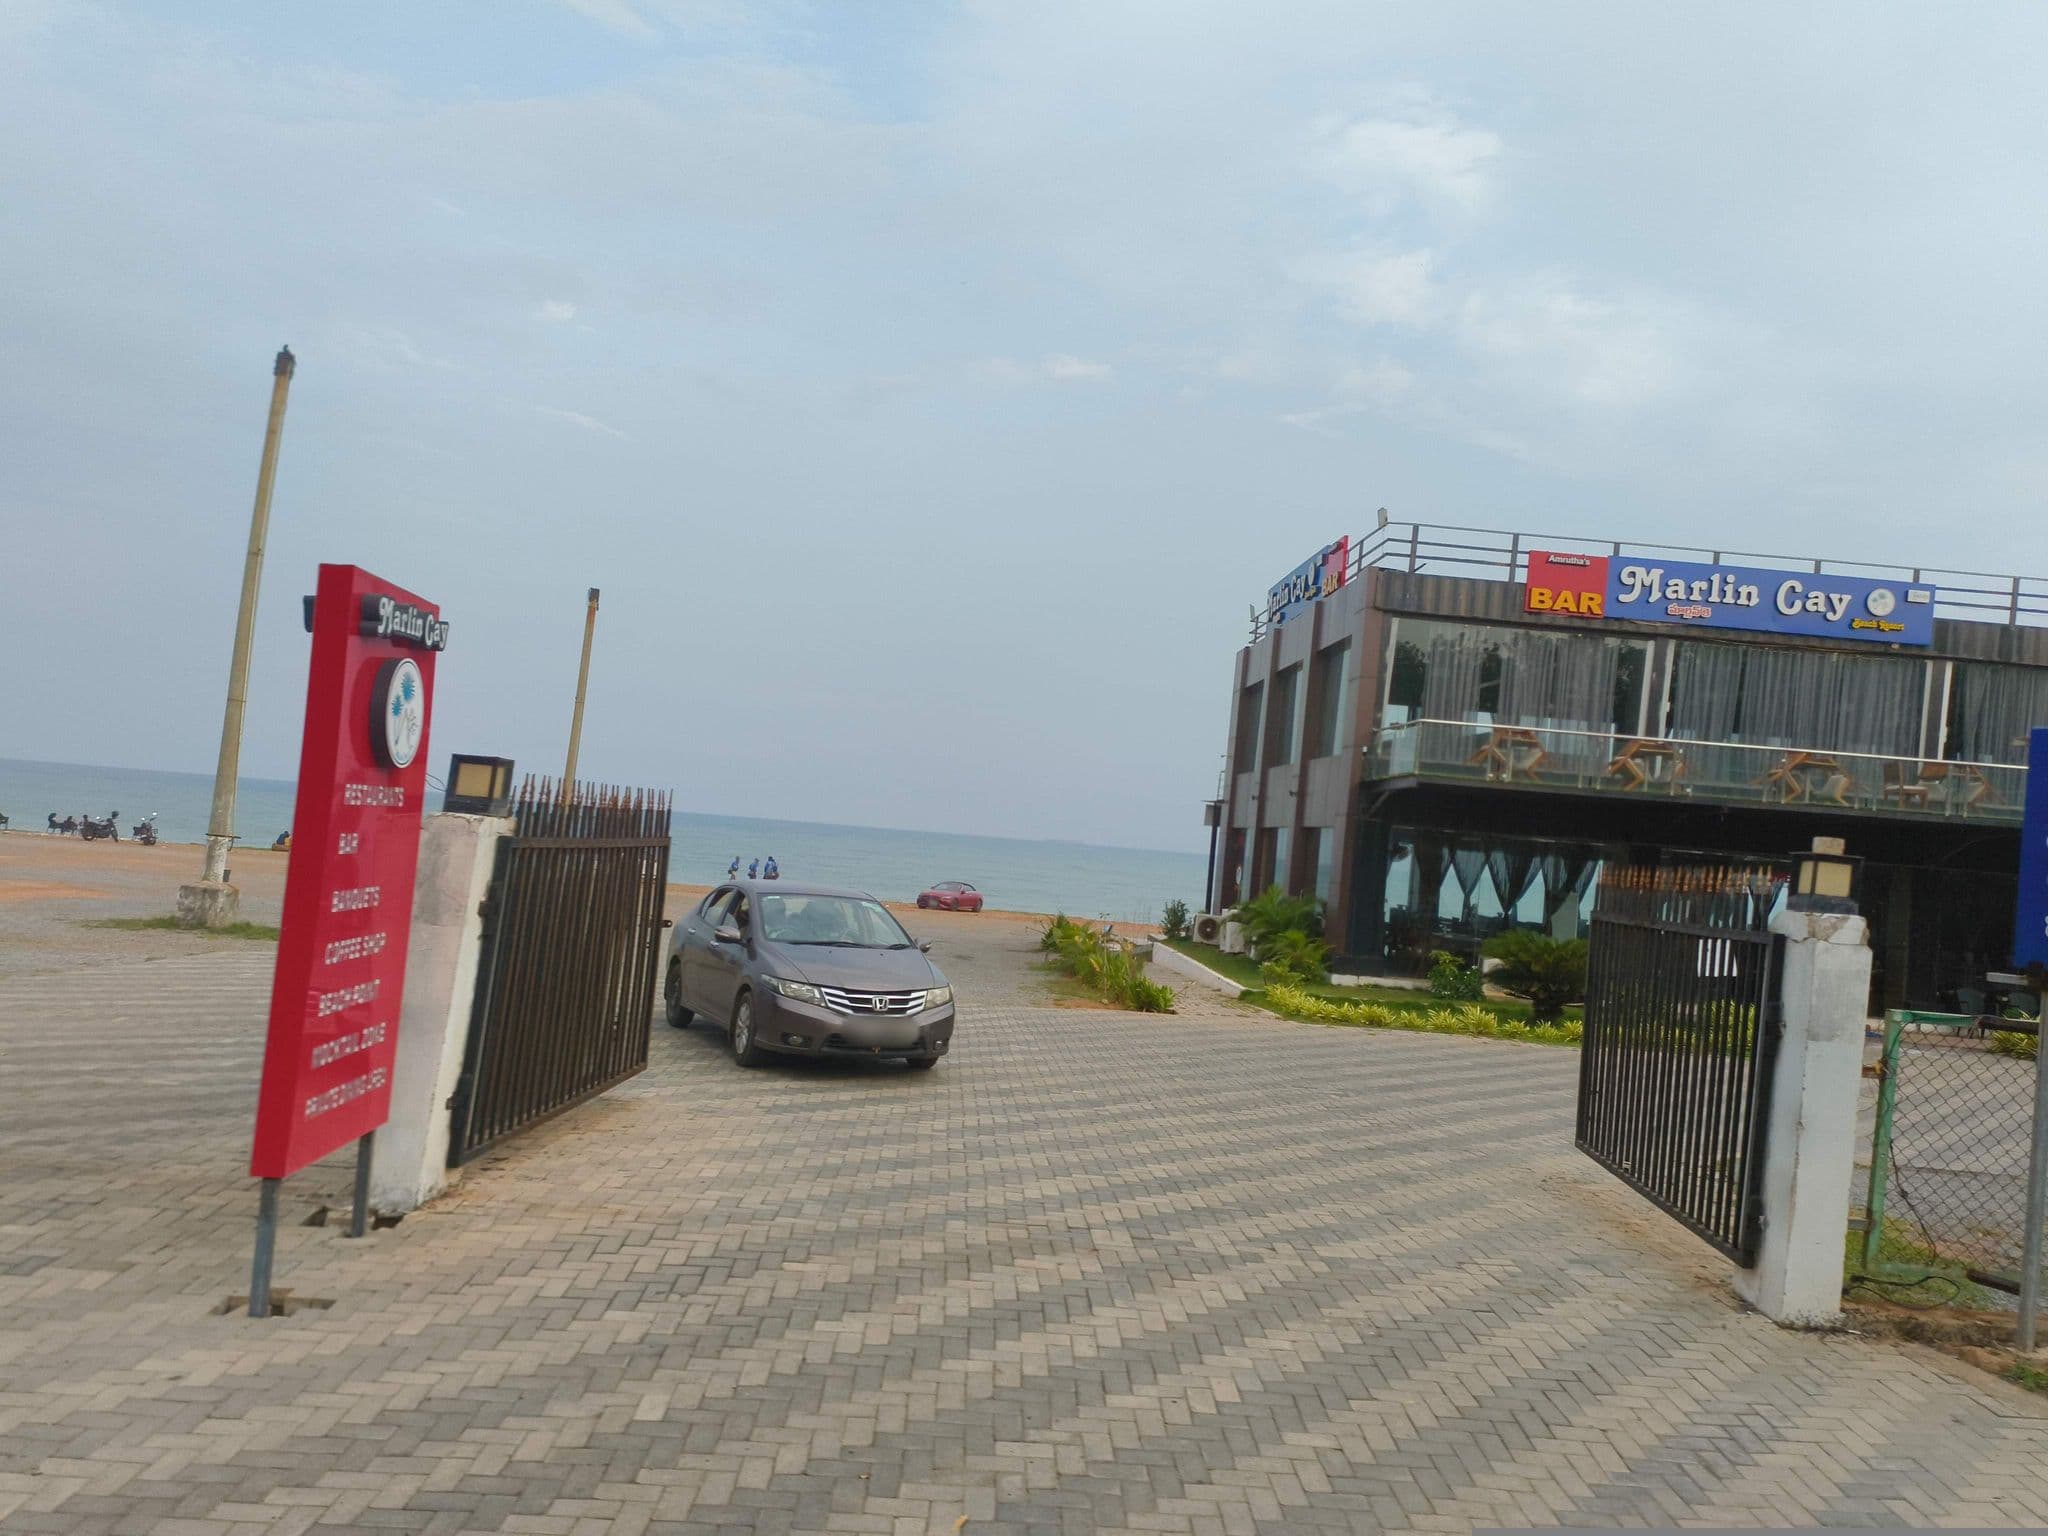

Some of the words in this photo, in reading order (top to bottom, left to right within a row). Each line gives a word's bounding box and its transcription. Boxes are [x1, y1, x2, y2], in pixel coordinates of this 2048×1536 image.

[1549, 554, 1591, 566] Amrutha's
[1322, 571, 1339, 598] BAR
[1618, 566, 1760, 607] Marlin
[1776, 579, 1852, 622] Cay
[1530, 587, 1603, 615] BAR
[378, 597, 424, 638] Marlin
[424, 613, 449, 649] Cay
[343, 783, 405, 807] RESTAURANTS
[338, 833, 359, 855] BAR
[331, 886, 381, 913] BANQUETS
[324, 937, 362, 965] COFFEE
[363, 932, 387, 957] SHOP
